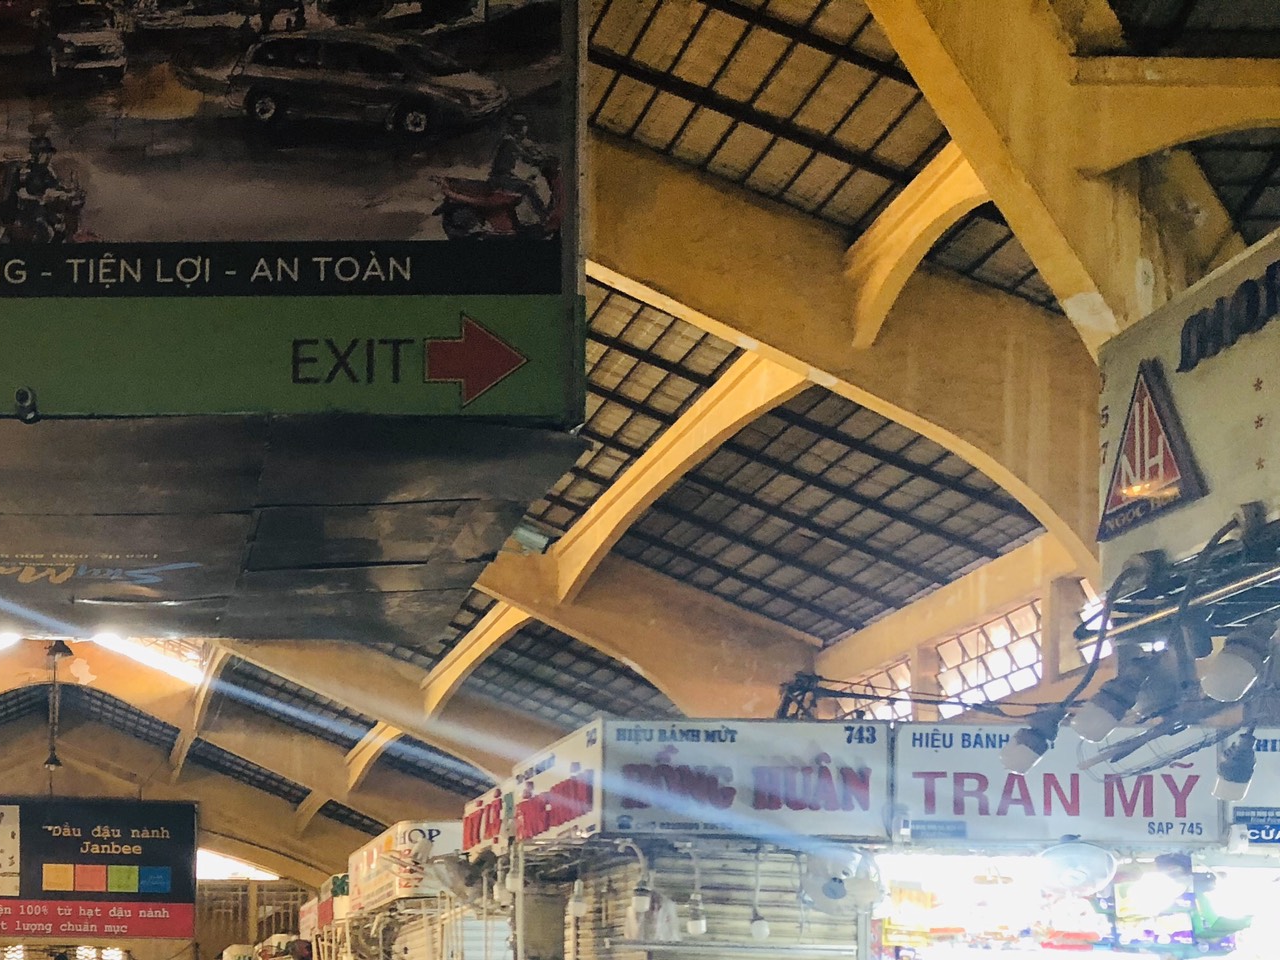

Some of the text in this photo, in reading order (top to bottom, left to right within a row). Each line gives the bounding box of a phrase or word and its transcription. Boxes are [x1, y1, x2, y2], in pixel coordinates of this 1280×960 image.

[66, 252, 142, 289] TIỆN
[156, 254, 210, 289] LỢI
[250, 256, 299, 283] AN
[312, 252, 413, 283] TOÀN
[291, 338, 415, 385] EXIT
[615, 724, 654, 746] HIỆU
[657, 723, 700, 743] BÁNH
[843, 725, 878, 745] 743
[911, 728, 954, 753] HIỆU
[961, 728, 1010, 749] BÁNH
[1103, 760, 1201, 819] MỸ
[91, 823, 122, 841] đậu
[130, 825, 170, 839] nành
[1179, 822, 1204, 836] 745
[79, 842, 143, 855] Janbee
[19, 904, 49, 916] 100%
[78, 906, 102, 919] hạt
[108, 906, 132, 920] đậu
[138, 907, 170, 919] nành
[14, 921, 53, 934] lượng
[59, 920, 99, 933] chuẩn
[104, 922, 128, 935] mục
